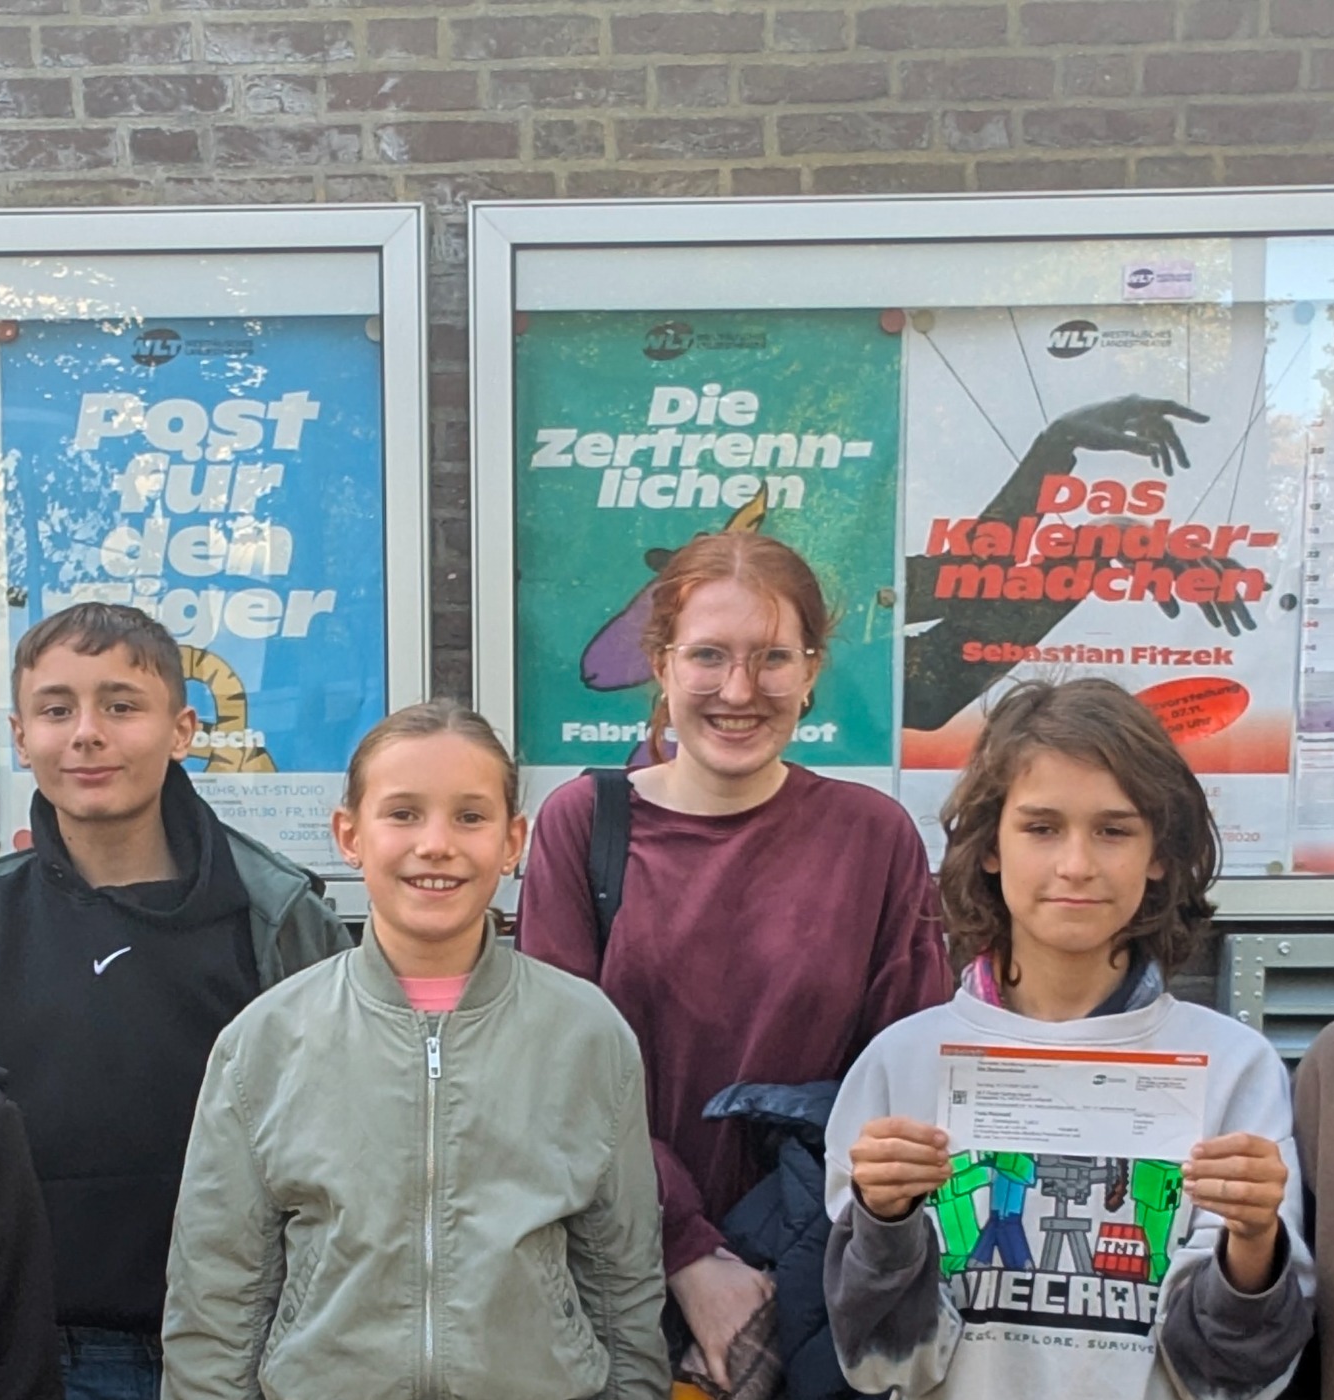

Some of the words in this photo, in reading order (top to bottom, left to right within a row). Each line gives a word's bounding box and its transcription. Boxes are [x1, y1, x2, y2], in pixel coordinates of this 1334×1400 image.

[75, 391, 321, 451] Post
[646, 383, 759, 426] Die
[531, 427, 873, 468] Zertrenn-
[112, 444, 285, 513] für
[597, 467, 805, 509] lichen
[1036, 474, 1168, 516] Das
[100, 516, 293, 577] den
[925, 515, 1280, 560] Kalender-
[934, 553, 1269, 602] mädchen
[962, 641, 1125, 664] Sebastian
[1130, 645, 1234, 665] Fitzek
[192, 728, 266, 749] osch
[1102, 1240, 1141, 1256] TNT
